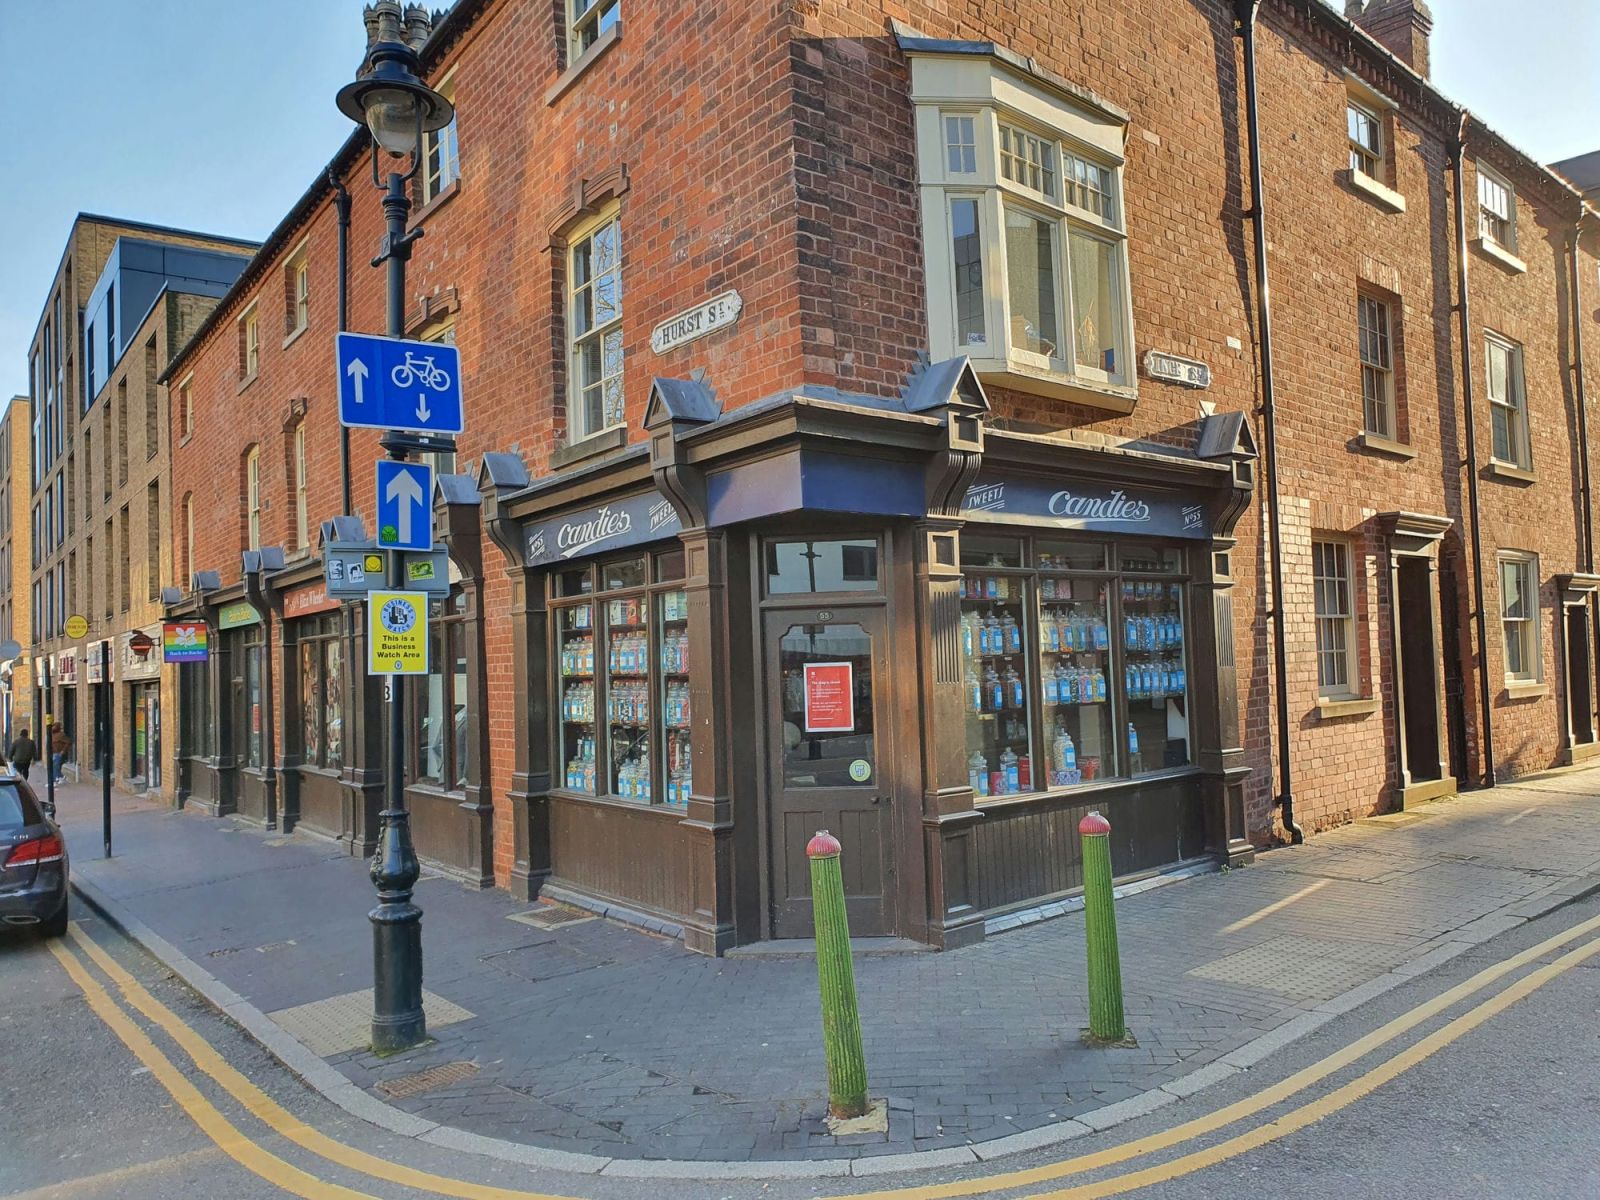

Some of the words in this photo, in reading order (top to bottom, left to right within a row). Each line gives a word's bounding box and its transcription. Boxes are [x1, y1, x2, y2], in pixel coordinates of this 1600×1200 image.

[662, 311, 702, 345] HURST
[968, 486, 1004, 509] SWEETS
[1048, 490, 1151, 522] Candies
[557, 505, 633, 550] Candies
[383, 599, 414, 614] BUSINESS
[387, 623, 411, 632] WATCH
